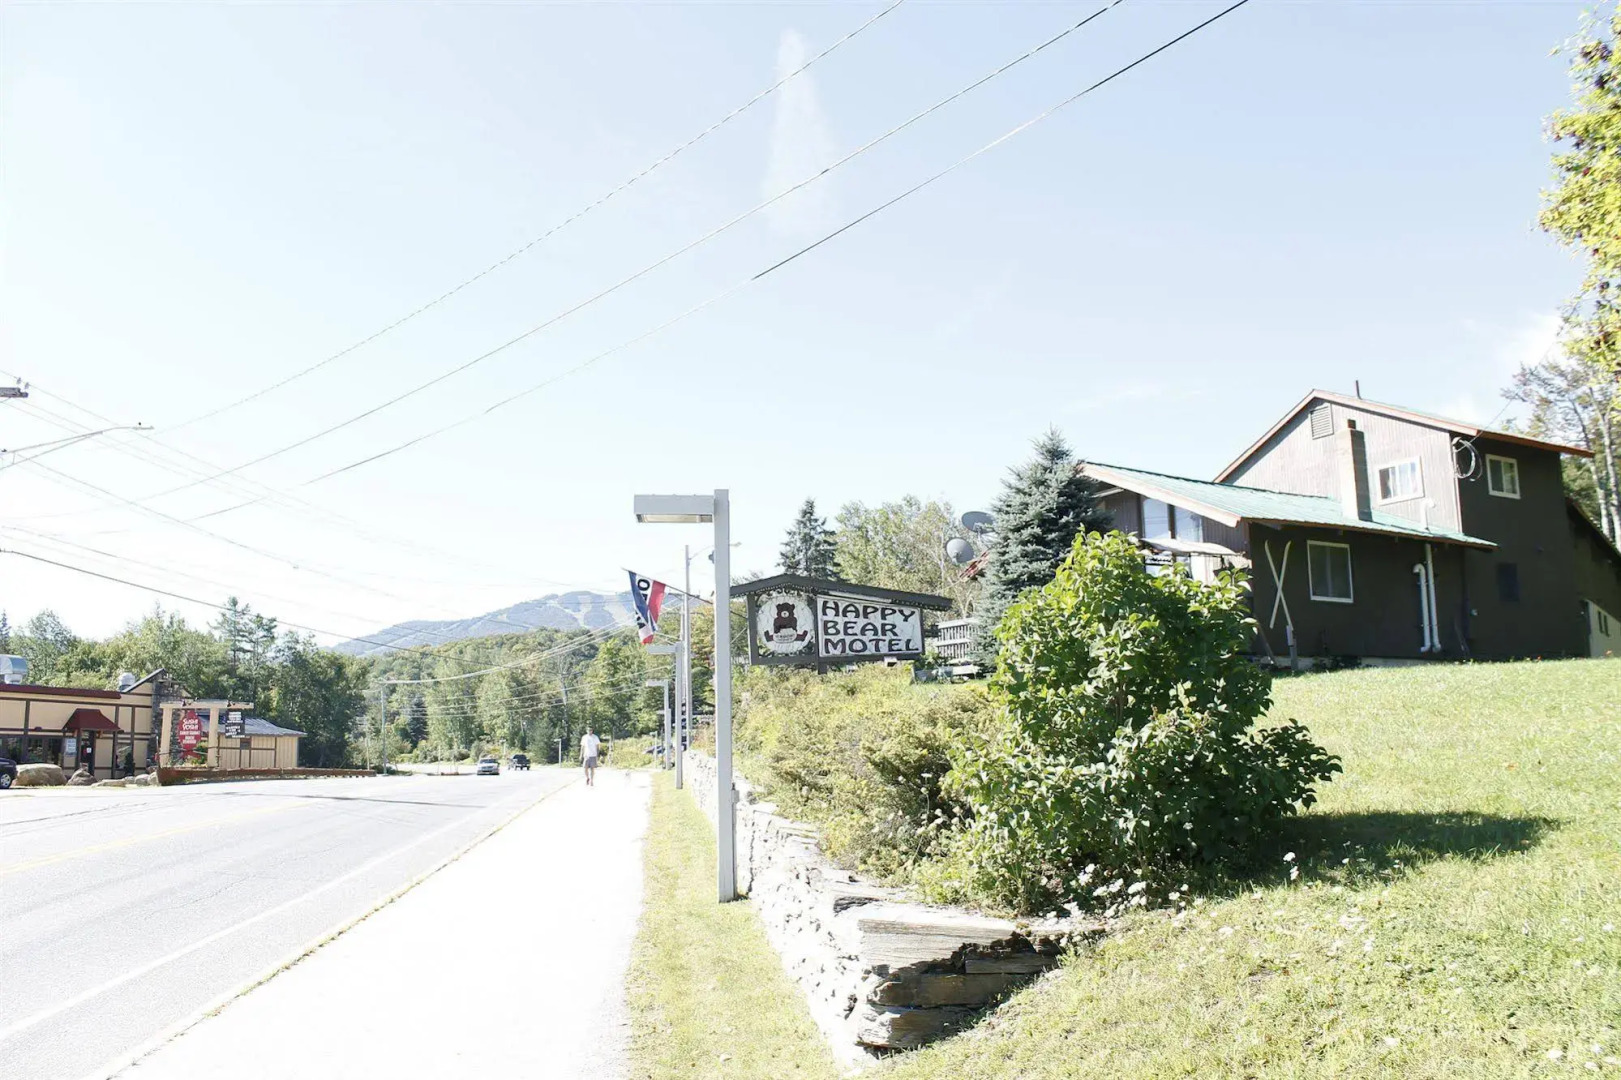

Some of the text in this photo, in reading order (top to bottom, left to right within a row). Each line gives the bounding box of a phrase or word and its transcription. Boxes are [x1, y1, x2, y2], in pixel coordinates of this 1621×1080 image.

[822, 601, 916, 622] HAPPY
[823, 620, 898, 637] BEAR
[824, 638, 919, 654] MOTEL
